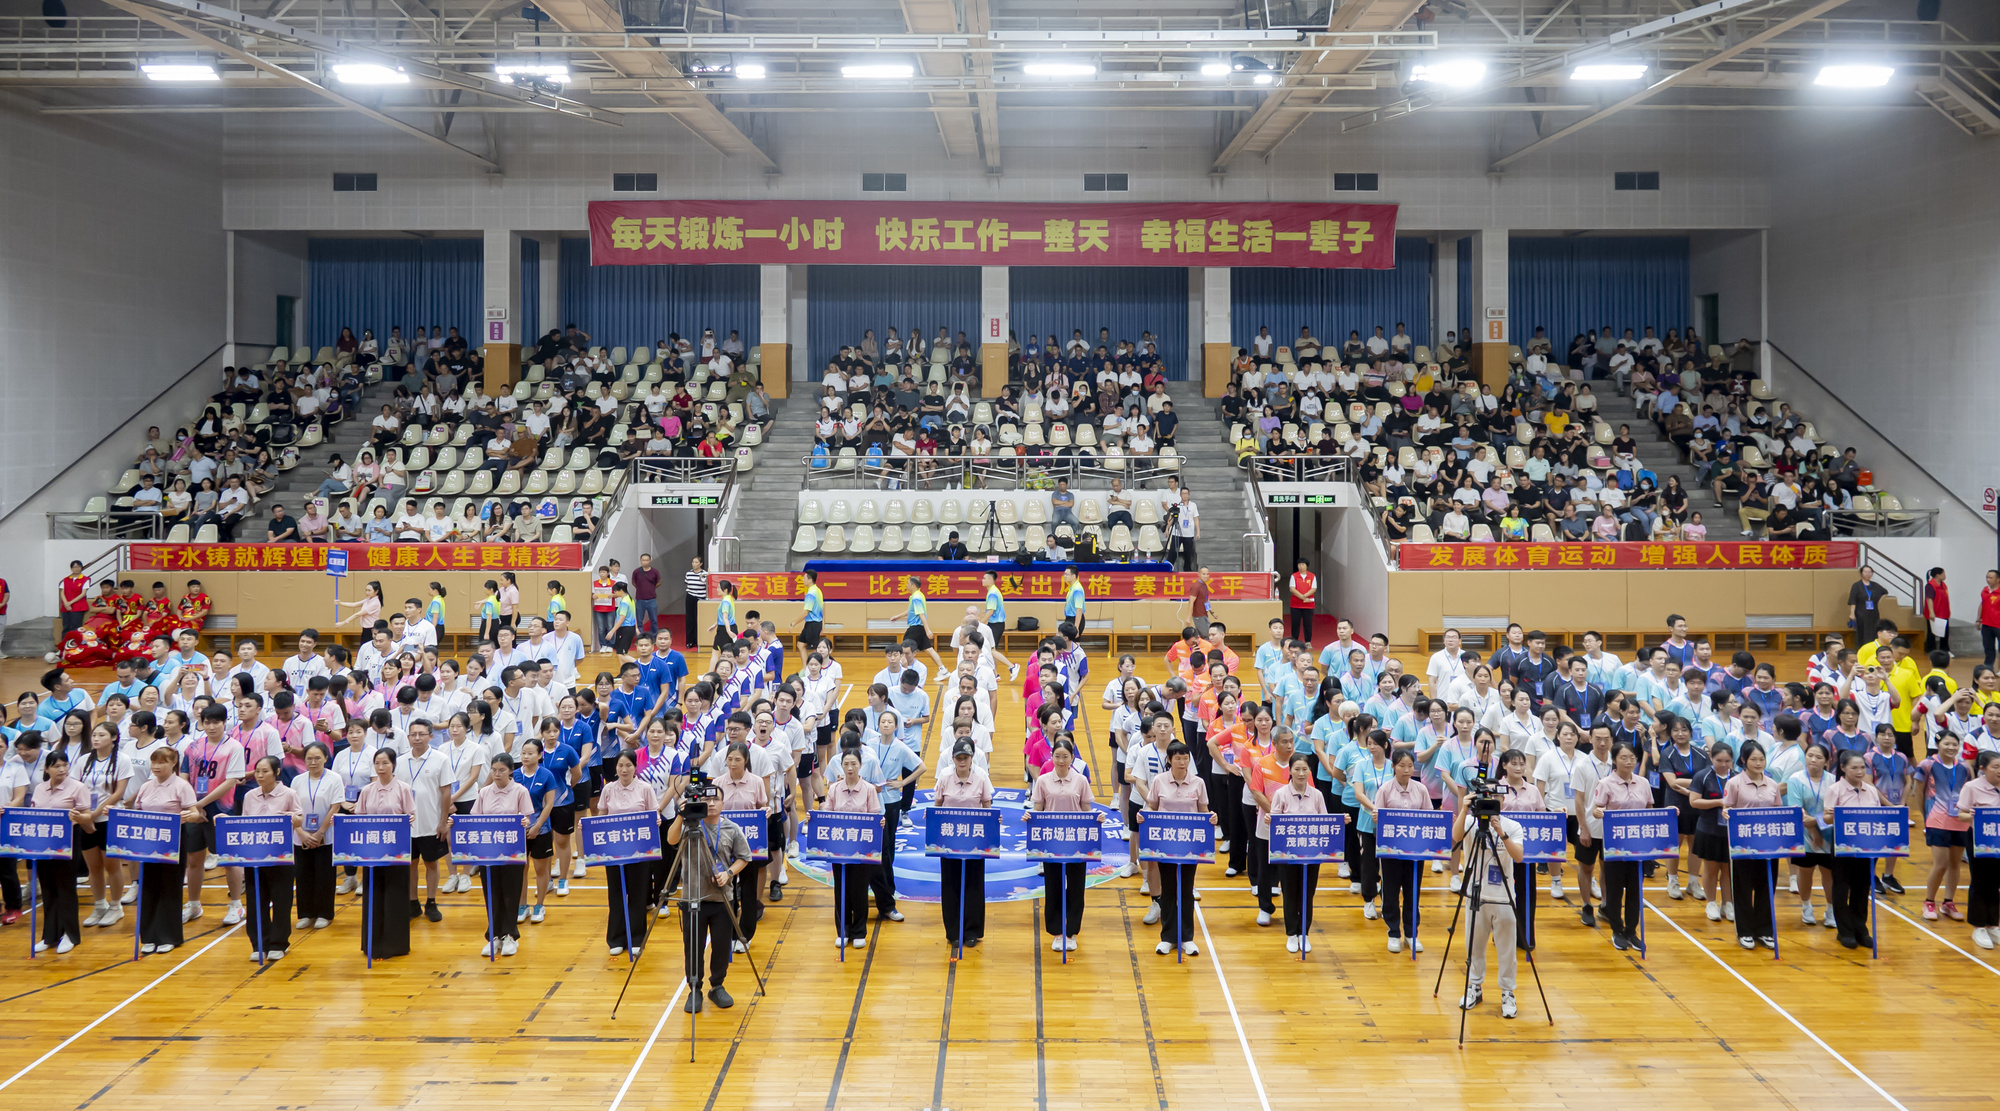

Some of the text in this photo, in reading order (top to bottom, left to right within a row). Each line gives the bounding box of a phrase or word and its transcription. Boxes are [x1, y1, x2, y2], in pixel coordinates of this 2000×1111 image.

[611, 217, 1375, 254] 每天锻炼一小时 快乐工作一整天 幸福生活一辈子
[367, 546, 560, 567] 健康人生更精彩
[1429, 544, 1827, 566] 发展体育运动 增强人民体质
[9, 822, 64, 838] 区城管局
[117, 825, 171, 842] 区卫健局
[593, 827, 651, 845] 区审计局
[739, 825, 759, 839] 院
[817, 826, 874, 842] 区教育局
[941, 823, 985, 837] 裁判员
[1031, 827, 1099, 842] 区市场监管局
[1149, 827, 1206, 842] 区政数局
[1275, 825, 1341, 836] 茂名农商银行
[1383, 825, 1447, 840] 露天矿街道
[1612, 824, 1670, 839] 河西街道
[1738, 822, 1796, 837] 新华街道
[1844, 822, 1900, 836] 区司法局
[1983, 822, 2000, 836] 城
[226, 831, 285, 845] 区财政局
[350, 830, 396, 844] 山阁镇
[455, 831, 518, 844] 区委宣传部
[1286, 836, 1330, 848] 茂南支行
